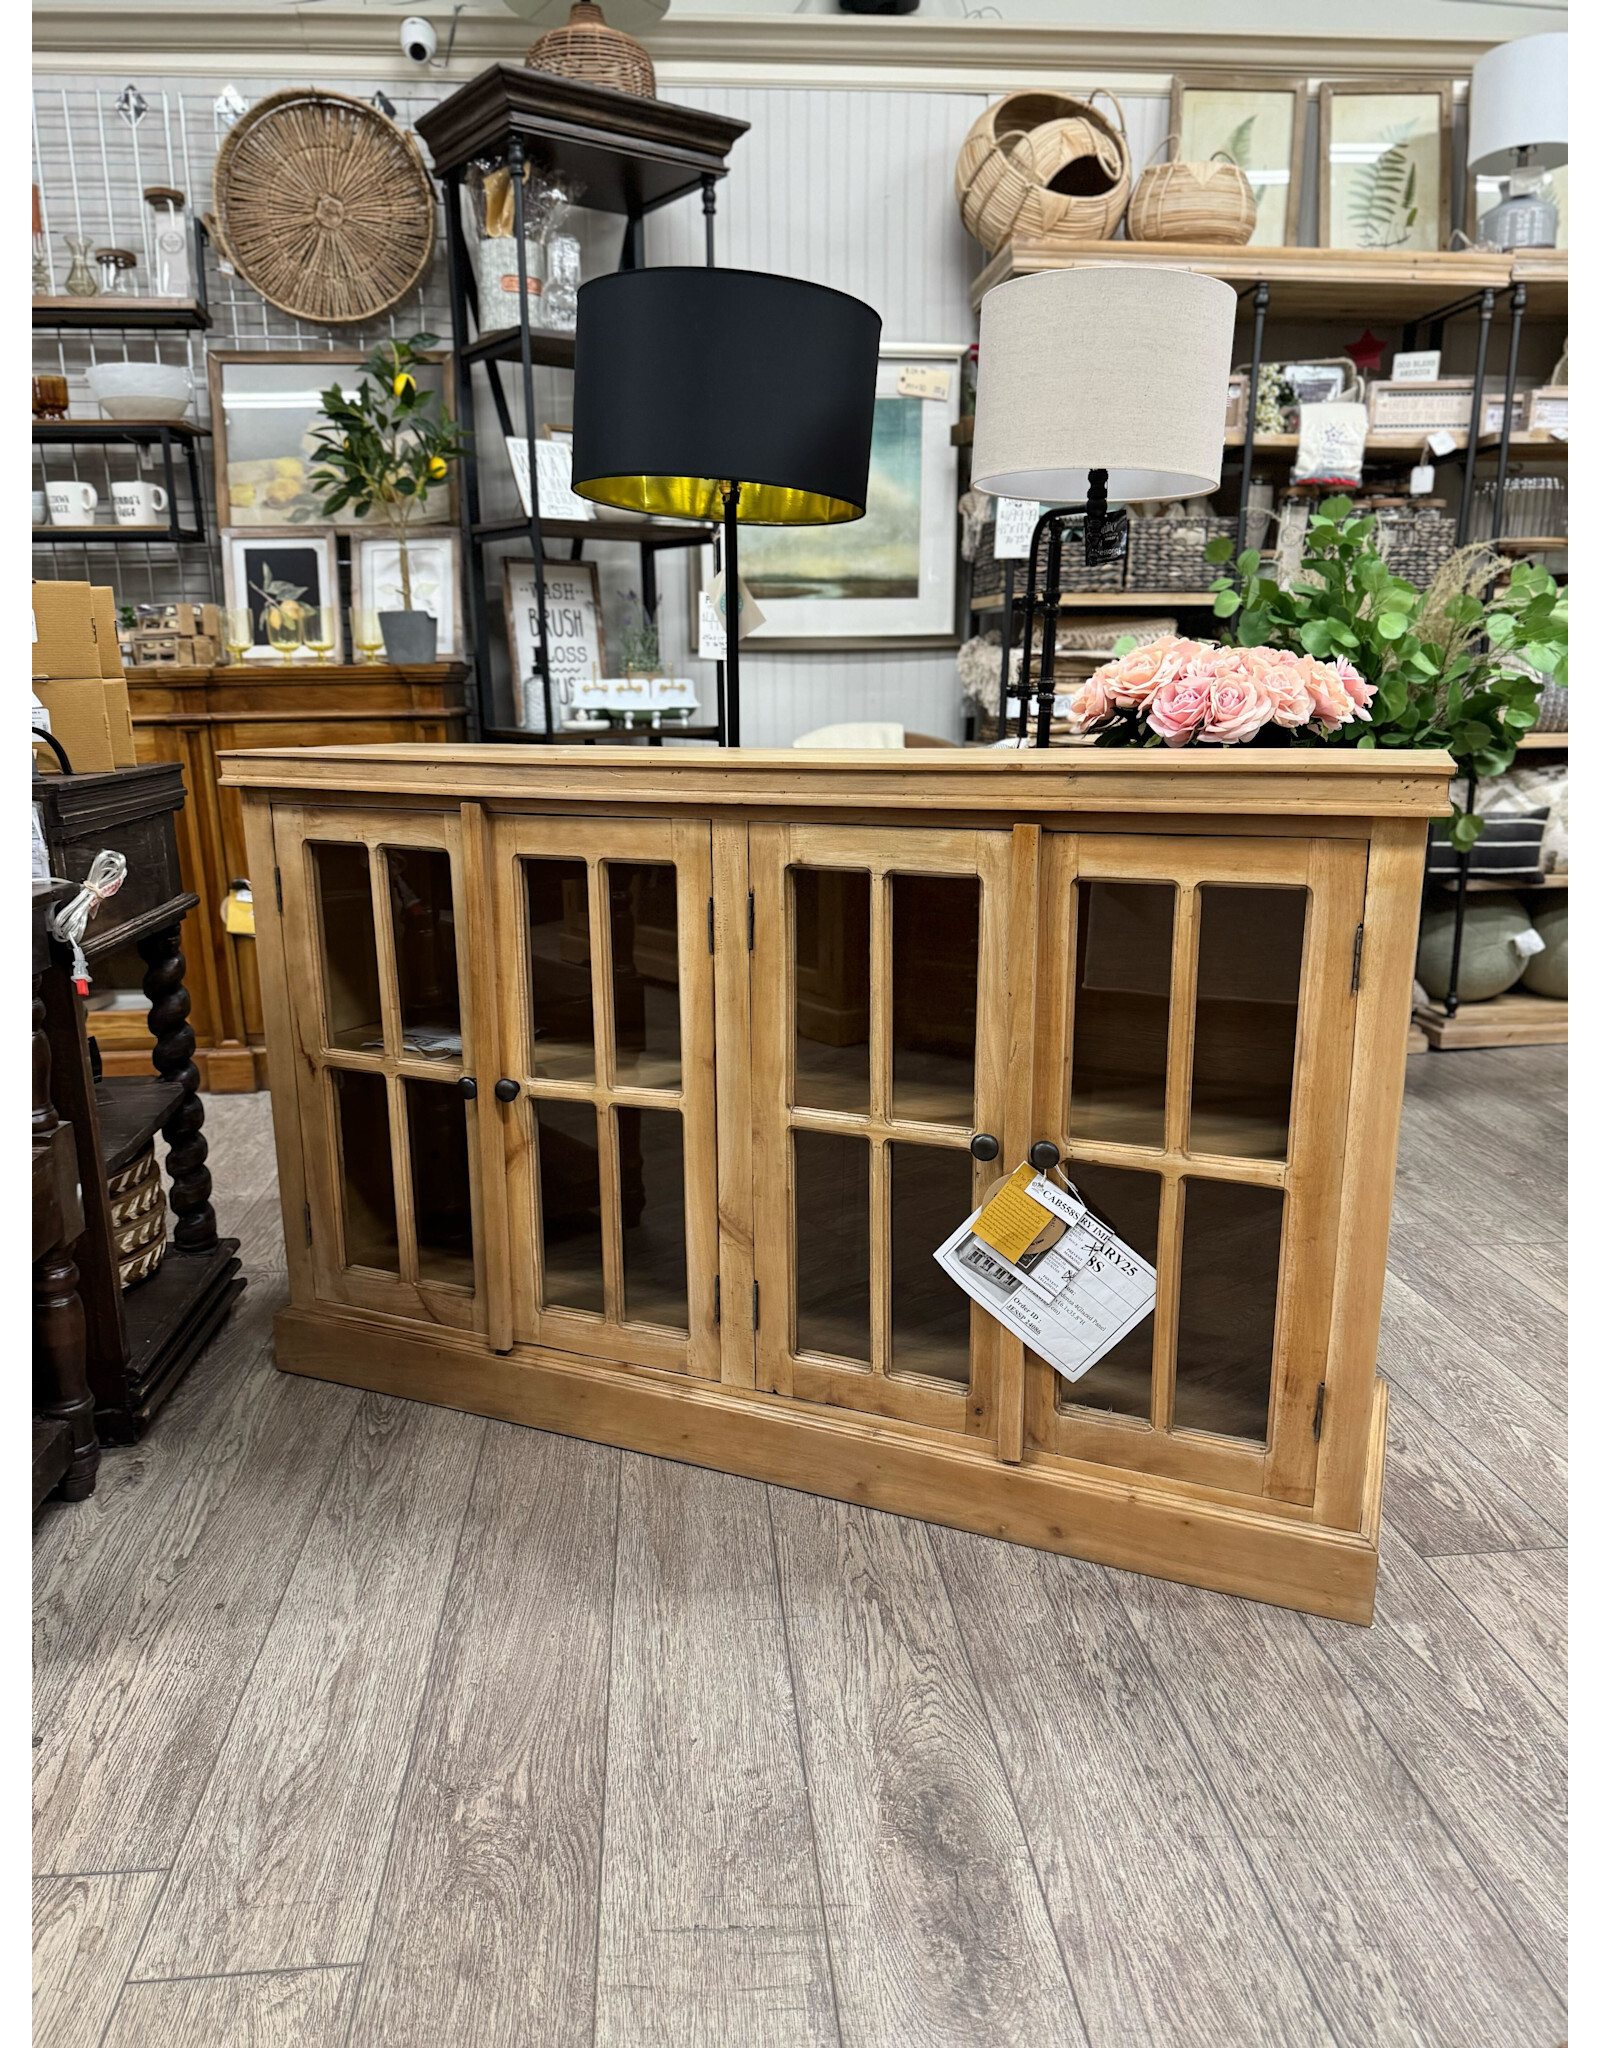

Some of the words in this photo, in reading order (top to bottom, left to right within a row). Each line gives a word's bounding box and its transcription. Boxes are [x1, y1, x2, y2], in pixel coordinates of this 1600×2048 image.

[1042, 1189, 1081, 1220] CAB558S
[1013, 1297, 1031, 1314] Order
[1030, 1312, 1039, 1320] ID
